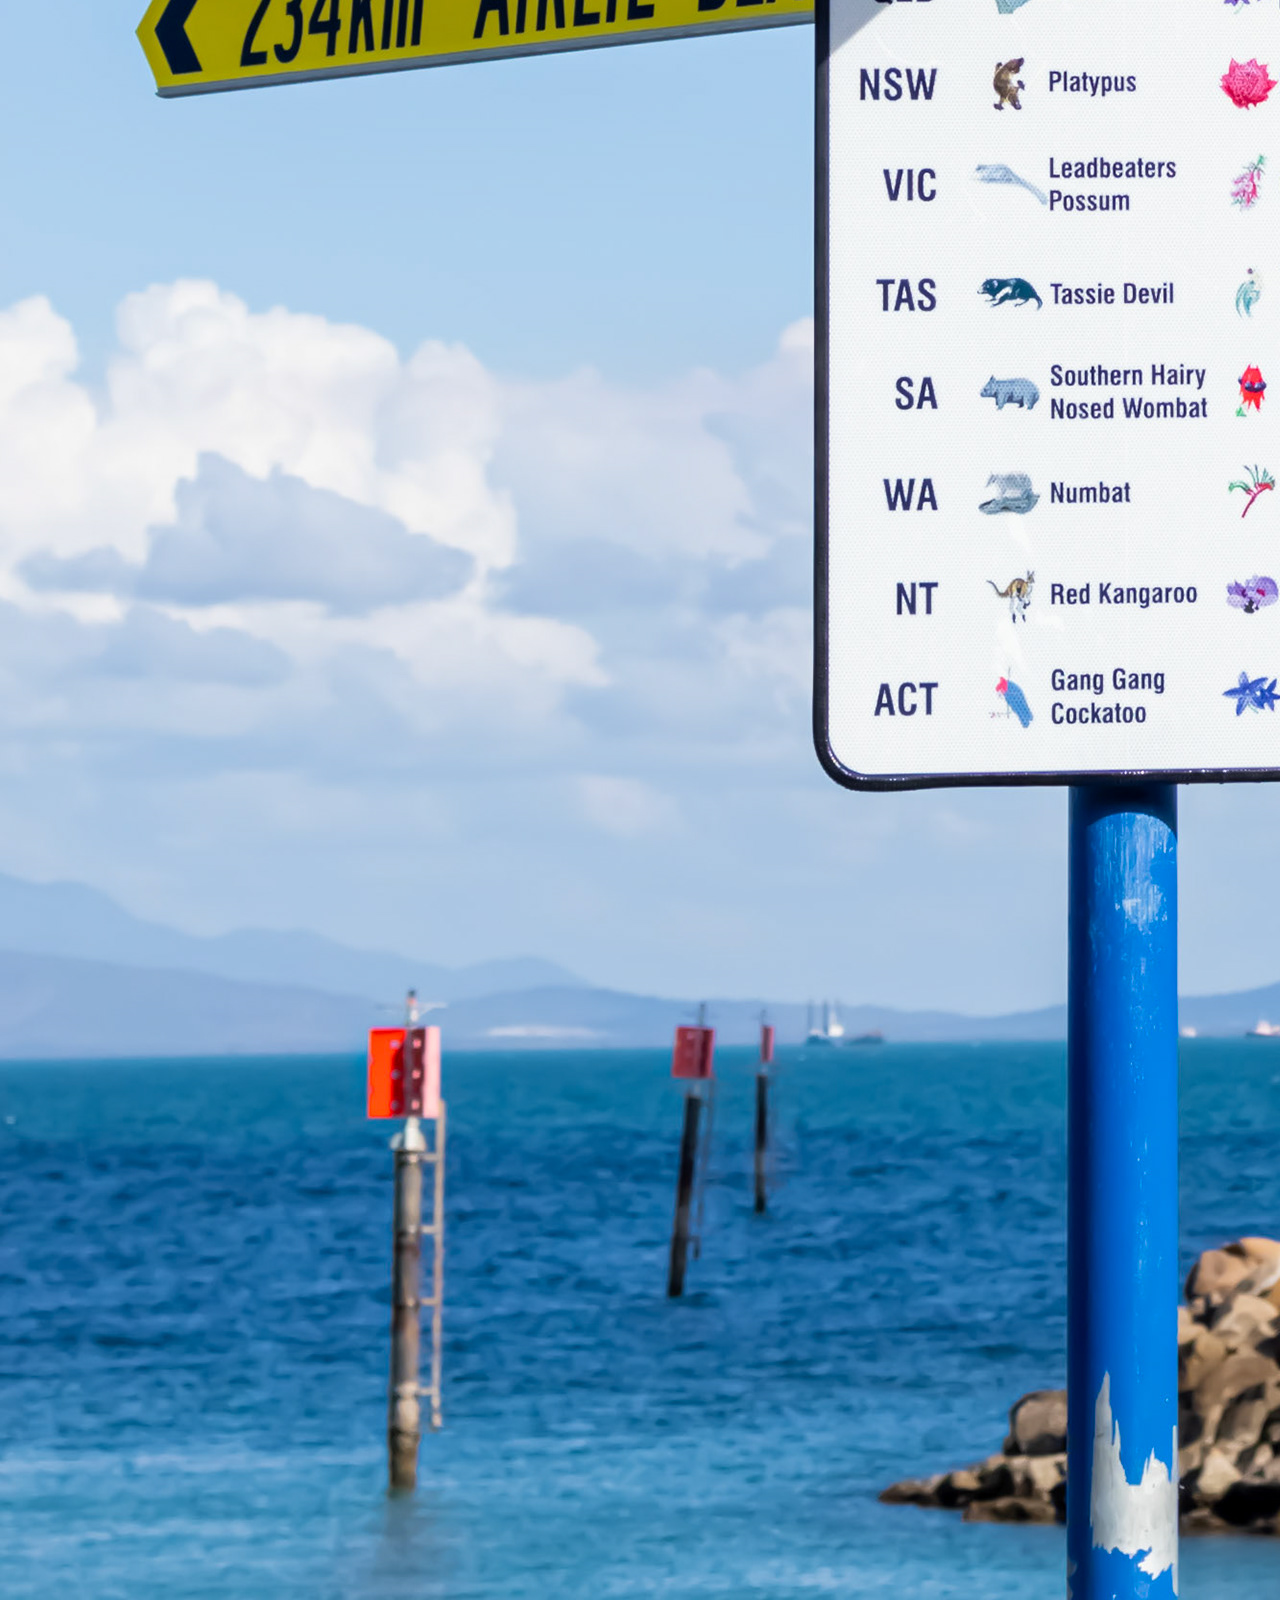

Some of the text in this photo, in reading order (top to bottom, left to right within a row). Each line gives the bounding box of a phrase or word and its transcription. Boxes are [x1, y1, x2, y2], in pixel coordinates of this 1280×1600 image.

[859, 68, 938, 101] NSW
[1049, 71, 1137, 96] Platypus
[1049, 157, 1177, 178] Leadbeaters
[882, 168, 937, 201] VIC
[1049, 190, 1130, 211] Possum
[875, 278, 937, 311] TAS
[1049, 283, 1174, 304] Tassie Devil
[1050, 364, 1206, 390] Southern Hairy
[895, 377, 939, 410] SA
[1050, 397, 1208, 419] Nosed Wombat
[882, 479, 939, 511] WA
[1050, 482, 1131, 503] Numbat
[896, 582, 939, 615] NT
[1050, 583, 1198, 608] Red Kangaroo
[1051, 668, 1165, 695] Gang Gang
[873, 682, 939, 716] ACT
[1051, 702, 1147, 724] Cockatoo
